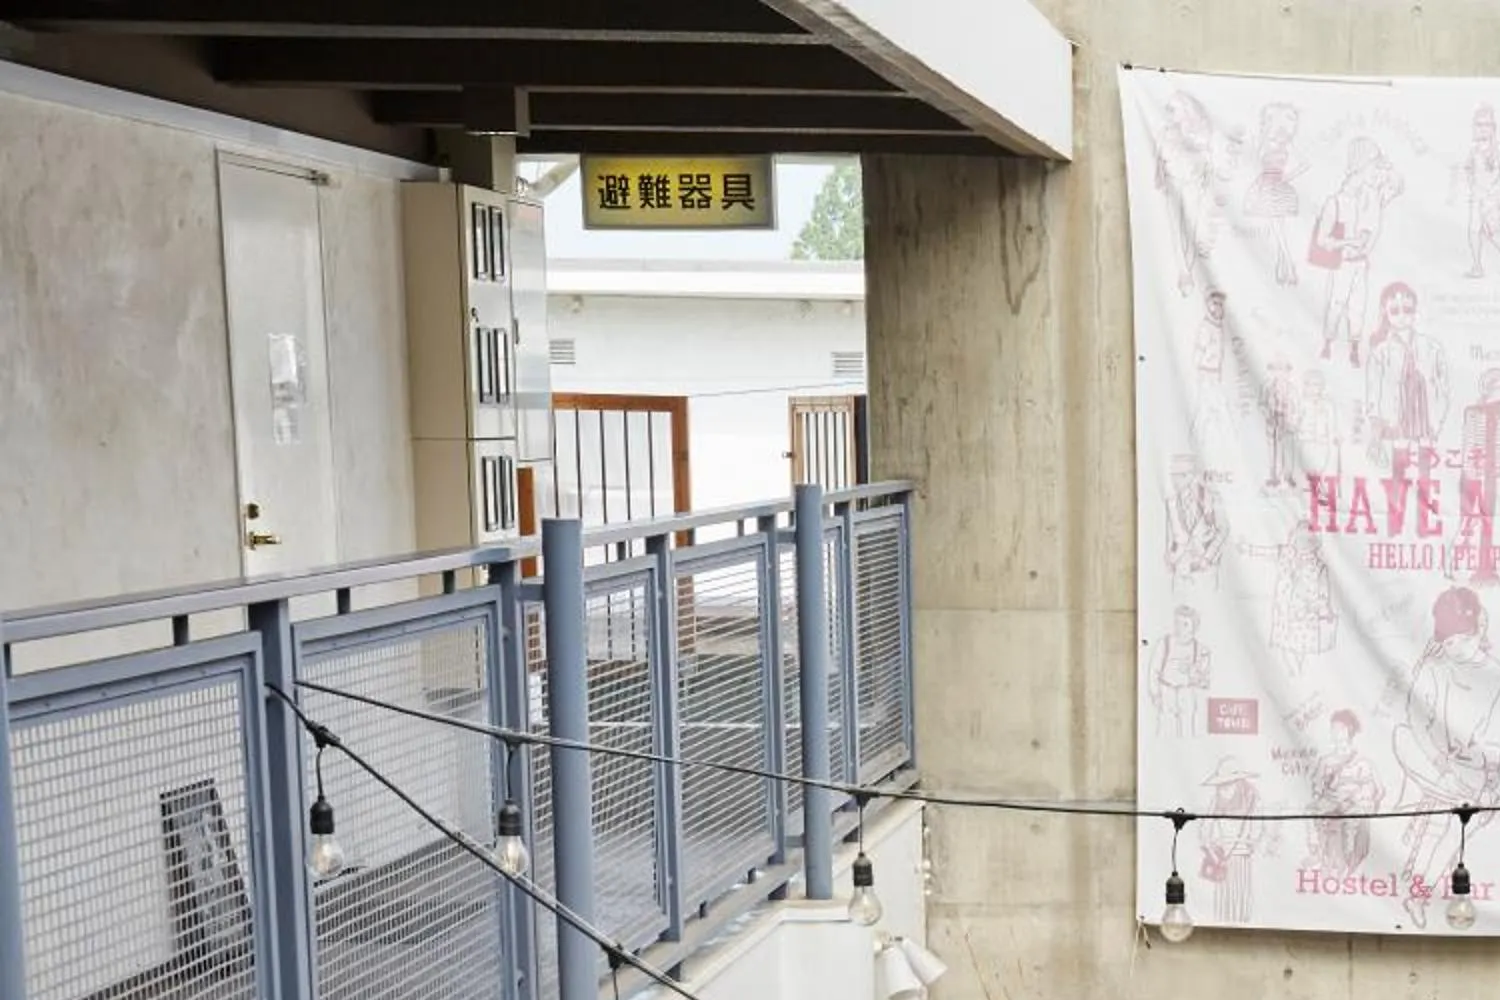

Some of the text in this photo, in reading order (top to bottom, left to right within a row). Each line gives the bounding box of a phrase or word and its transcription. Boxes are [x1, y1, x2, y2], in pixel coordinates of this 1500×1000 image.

[597, 173, 756, 211] 避難器具
[1307, 475, 1443, 538] HAVE
[1460, 478, 1493, 538] A
[1296, 868, 1399, 897] Hostel
[1409, 873, 1433, 899] &
